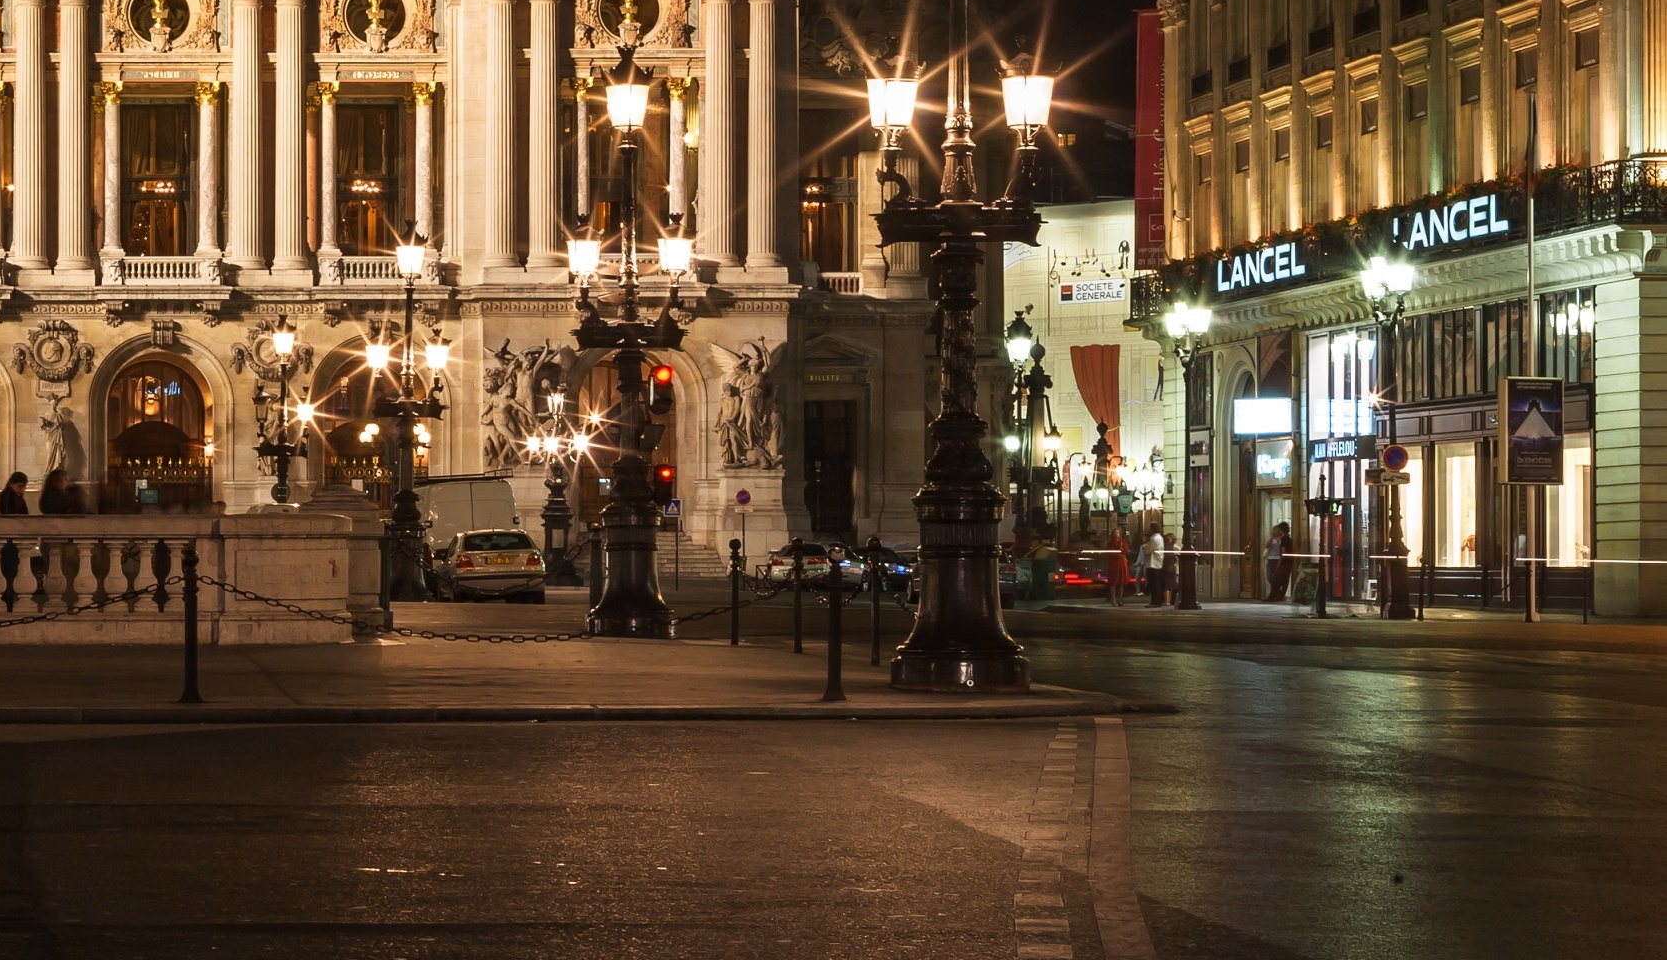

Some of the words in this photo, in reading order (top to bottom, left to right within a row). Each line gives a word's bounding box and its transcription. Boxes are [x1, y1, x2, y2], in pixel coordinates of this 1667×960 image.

[1393, 193, 1509, 251] LANCEL
[1217, 242, 1306, 291] LANCEL
[1075, 282, 1114, 292] SOCIETE
[1075, 291, 1123, 301] GENERALE
[1326, 440, 1355, 458] AFFLELOU
